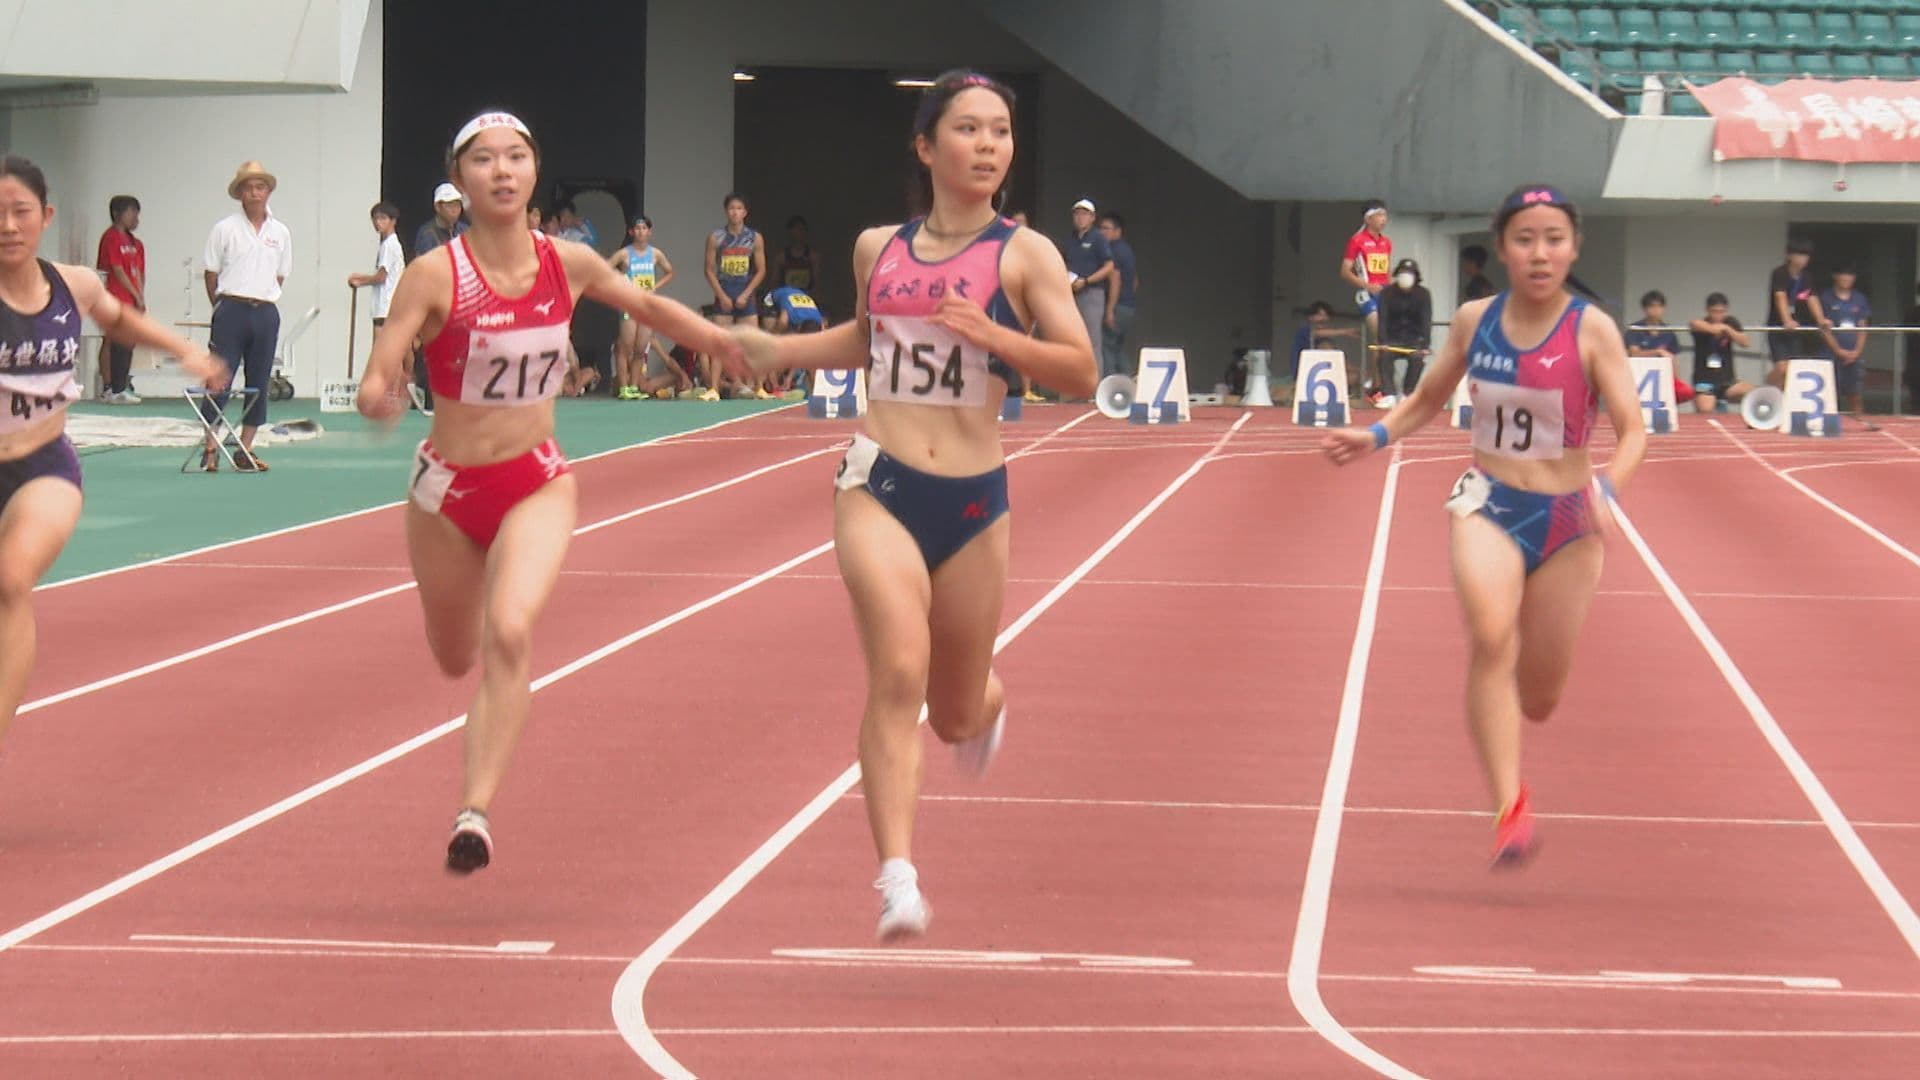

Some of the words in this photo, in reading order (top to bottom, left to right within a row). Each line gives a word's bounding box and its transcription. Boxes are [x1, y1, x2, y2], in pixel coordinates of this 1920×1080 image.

[483, 350, 560, 399] 217
[890, 342, 965, 398] 154
[1146, 360, 1178, 408] 7
[1306, 361, 1338, 407] 6
[1637, 369, 1666, 414] 4
[1796, 371, 1825, 420] 3
[1494, 405, 1534, 452] 19
